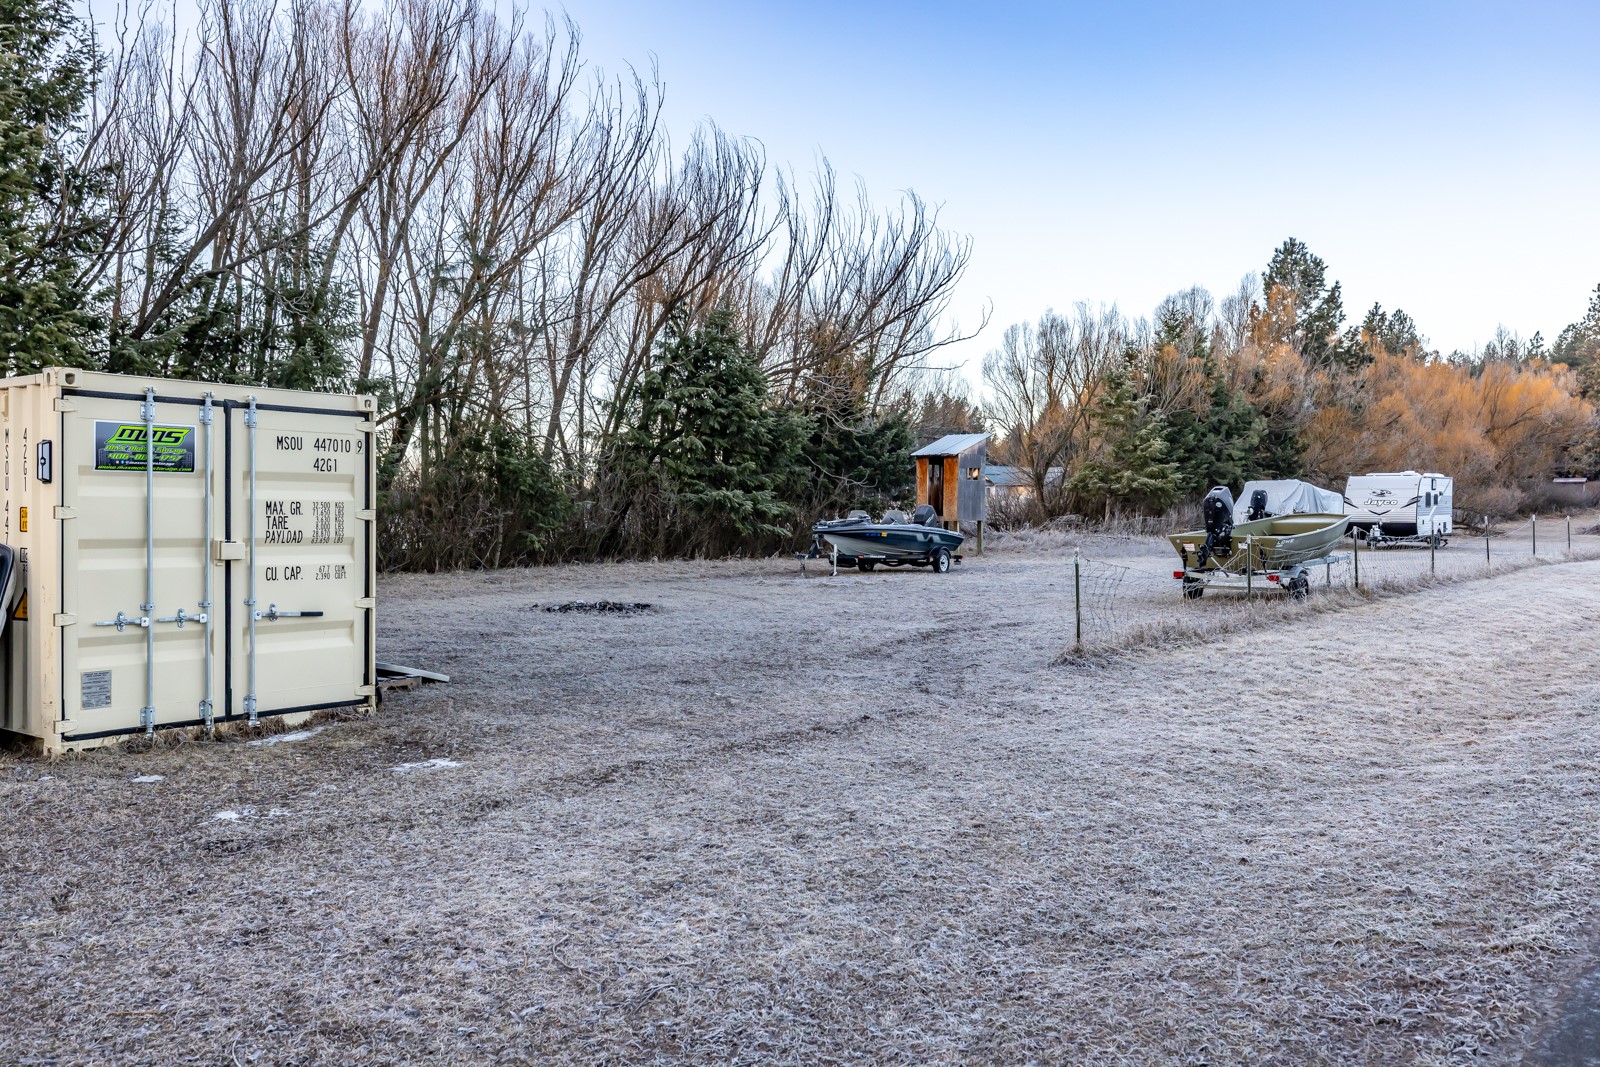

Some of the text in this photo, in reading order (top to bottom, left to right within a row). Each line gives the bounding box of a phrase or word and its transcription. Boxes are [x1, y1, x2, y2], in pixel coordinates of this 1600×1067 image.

[276, 435, 363, 453] MSOU 447010 9
[108, 452, 182, 461] 406-80-1757
[313, 457, 337, 473] 42G1
[265, 501, 303, 516] MAX. GR.
[1363, 498, 1398, 507] Jayco
[266, 516, 289, 529] TARE
[264, 530, 303, 544] PAYLOAD
[265, 566, 303, 581] CU. CAP.
